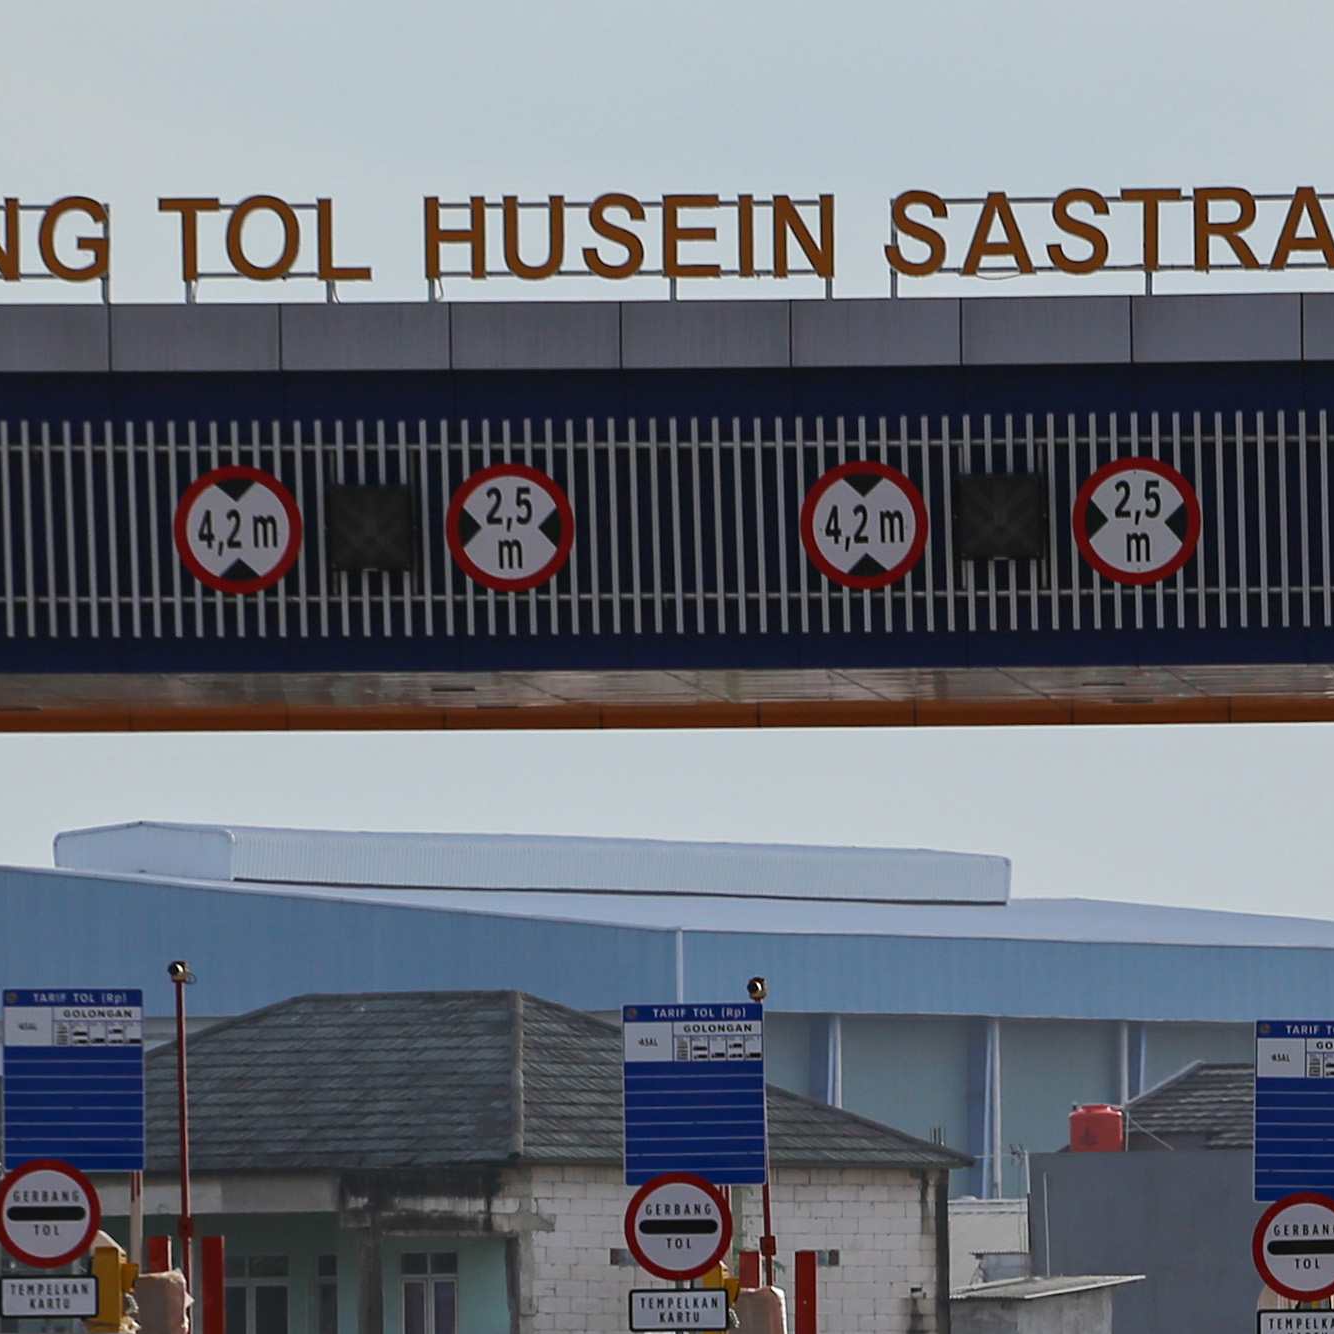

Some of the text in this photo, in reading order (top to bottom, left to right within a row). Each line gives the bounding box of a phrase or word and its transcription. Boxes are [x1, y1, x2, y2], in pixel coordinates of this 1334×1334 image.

[160, 196, 371, 282] TOL
[427, 193, 833, 279] HUSEIN
[1113, 479, 1163, 526] 2,5
[484, 486, 534, 533] 2,5
[196, 508, 279, 557] 4,2 m
[823, 503, 906, 553] 4,2 m
[496, 538, 524, 570] m
[1124, 532, 1152, 563] m
[72, 991, 95, 1004] TOL
[62, 1008, 134, 1019] GOLONGAN
[652, 1006, 747, 1020] TARIF TOL (Rp)
[683, 1022, 753, 1034] GOLONGAN
[1285, 1024, 1320, 1035] TARIF
[13, 1190, 81, 1203] GERBANG
[644, 1203, 713, 1216] GERBANG
[33, 1224, 61, 1236] TOL
[665, 1237, 693, 1250] TOL
[1294, 1258, 1321, 1270] TOL
[9, 1283, 90, 1296] TEMPELKAN
[29, 1297, 71, 1310] KARTU
[639, 1297, 719, 1310] TEMPELKAN
[658, 1311, 701, 1324] KARTU
